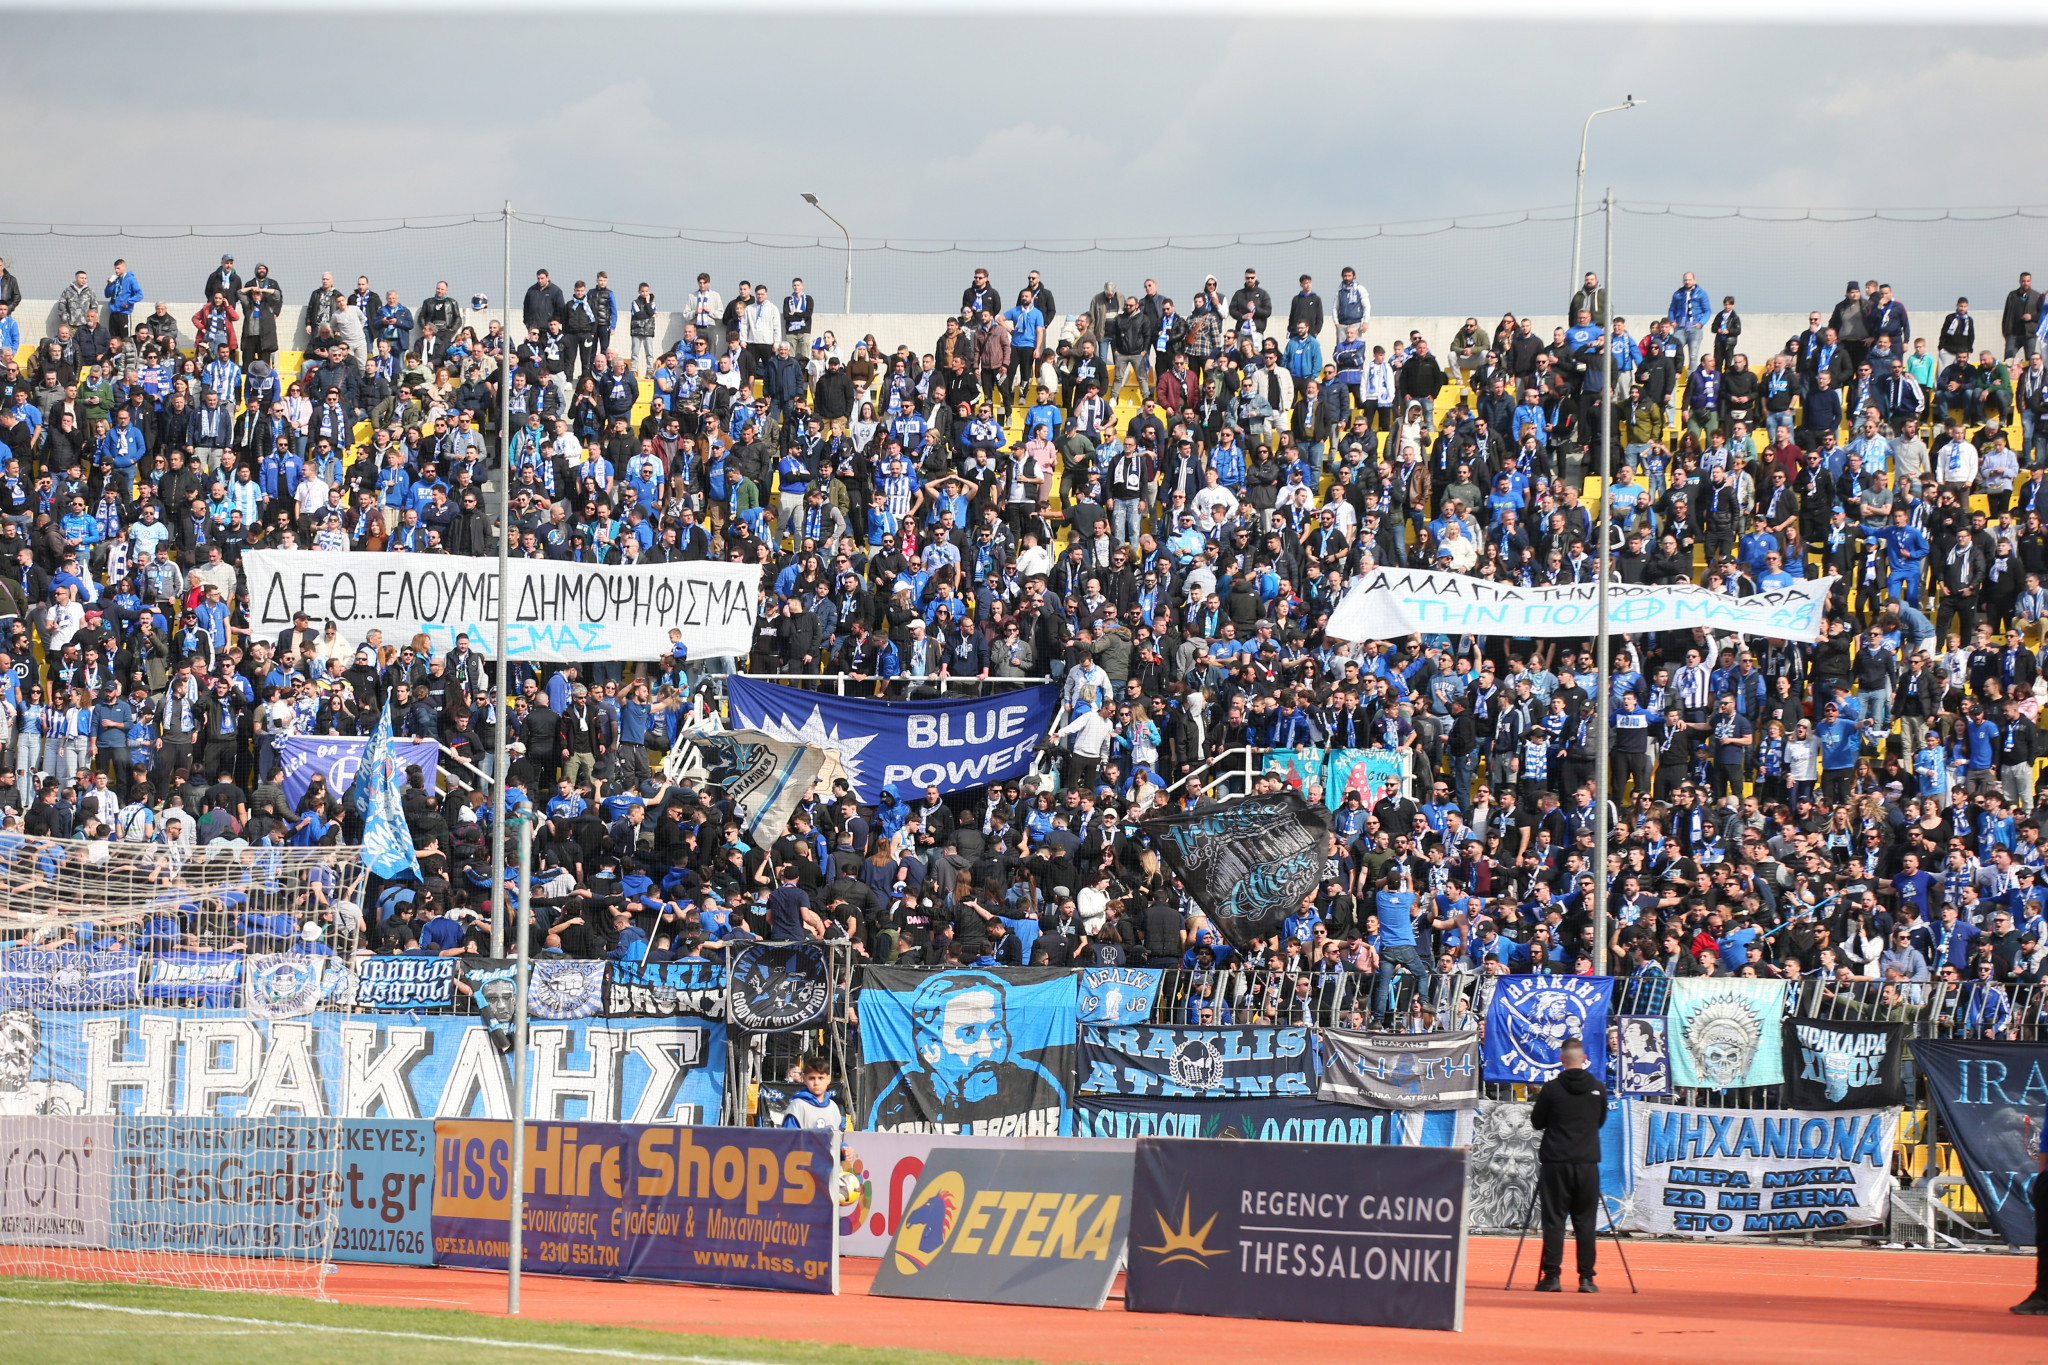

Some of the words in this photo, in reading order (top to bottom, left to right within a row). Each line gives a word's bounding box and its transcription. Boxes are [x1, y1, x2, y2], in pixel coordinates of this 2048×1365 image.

[516, 573, 753, 627] ΔΗΜΟΨΗΦΙΣΜΑ
[1364, 571, 1462, 598] ΑΛΛΑ
[1470, 583, 1524, 602] ΓΙΑ
[1532, 586, 1596, 602] ΤΗΝ
[1402, 597, 1509, 625] ΤΗΝ
[906, 705, 1029, 749] BLUE
[884, 732, 1040, 789] POWER
[772, 1009, 809, 1027] WHITE
[805, 982, 826, 1015] PRIDE
[1081, 996, 1100, 1012] 19
[1371, 1039, 1428, 1049] ΗΡΑΚΛΗΣ
[80, 1014, 704, 1126] ΗΡΑΚΛΗΣ
[1953, 1059, 2048, 1106] IRA
[1358, 1088, 1392, 1100] ΑΙΩΝΙΑ
[1396, 1093, 1439, 1101] ΛΑΤΡΕΙΑ
[1645, 1110, 1885, 1168] ΜΗΧΑΝΙΩΝΑ
[122, 1154, 426, 1224] ThesGadget.gr
[440, 1137, 510, 1202] HSS
[523, 1126, 623, 1200] Hire
[636, 1127, 817, 1216] Shops
[1668, 1166, 1751, 1189] ΜΕΡΑ
[1762, 1166, 1857, 1189] ΝΥΧΤΑ
[1240, 1189, 1350, 1219] REGENCY
[1358, 1194, 1455, 1223] CASINO
[1663, 1188, 1706, 1209] ΖΩ
[1718, 1192, 1761, 1210] ΜΕ
[1771, 1187, 1859, 1209] ΕΣΕΝΑ
[611, 1205, 681, 1243] Εγαλείων
[684, 1206, 696, 1240] &
[706, 1206, 811, 1251] Μηχανημάτων
[951, 1189, 1122, 1262] ETEKA
[1673, 1210, 1733, 1232] ΣΤΟ
[1743, 1209, 1849, 1232] ΜΥΑΛΟ
[332, 1226, 426, 1255] 2310217626
[539, 1240, 571, 1264] 2310
[692, 1249, 830, 1281] www.hss.gr
[1238, 1240, 1452, 1284] THESSALONIKI
